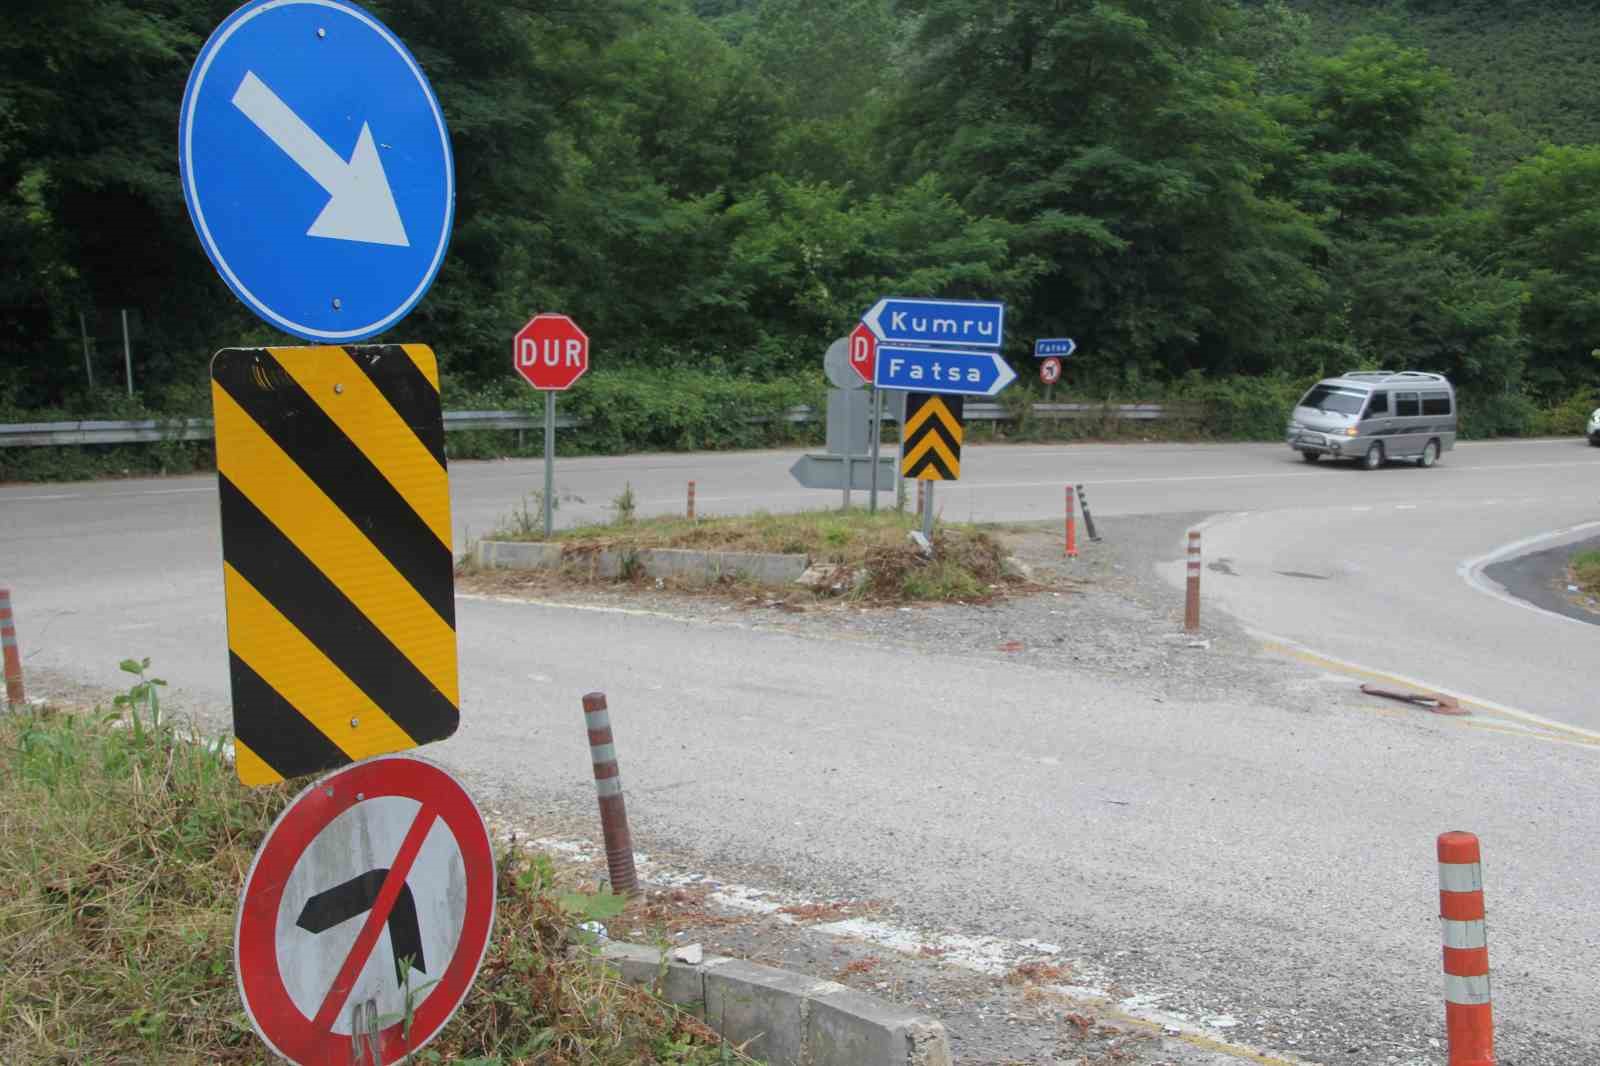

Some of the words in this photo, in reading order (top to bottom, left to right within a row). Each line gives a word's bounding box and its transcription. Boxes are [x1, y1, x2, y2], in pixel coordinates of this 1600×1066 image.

[891, 311, 993, 336] Kumru
[521, 338, 582, 368] DUR
[889, 358, 981, 382] Fatsa
